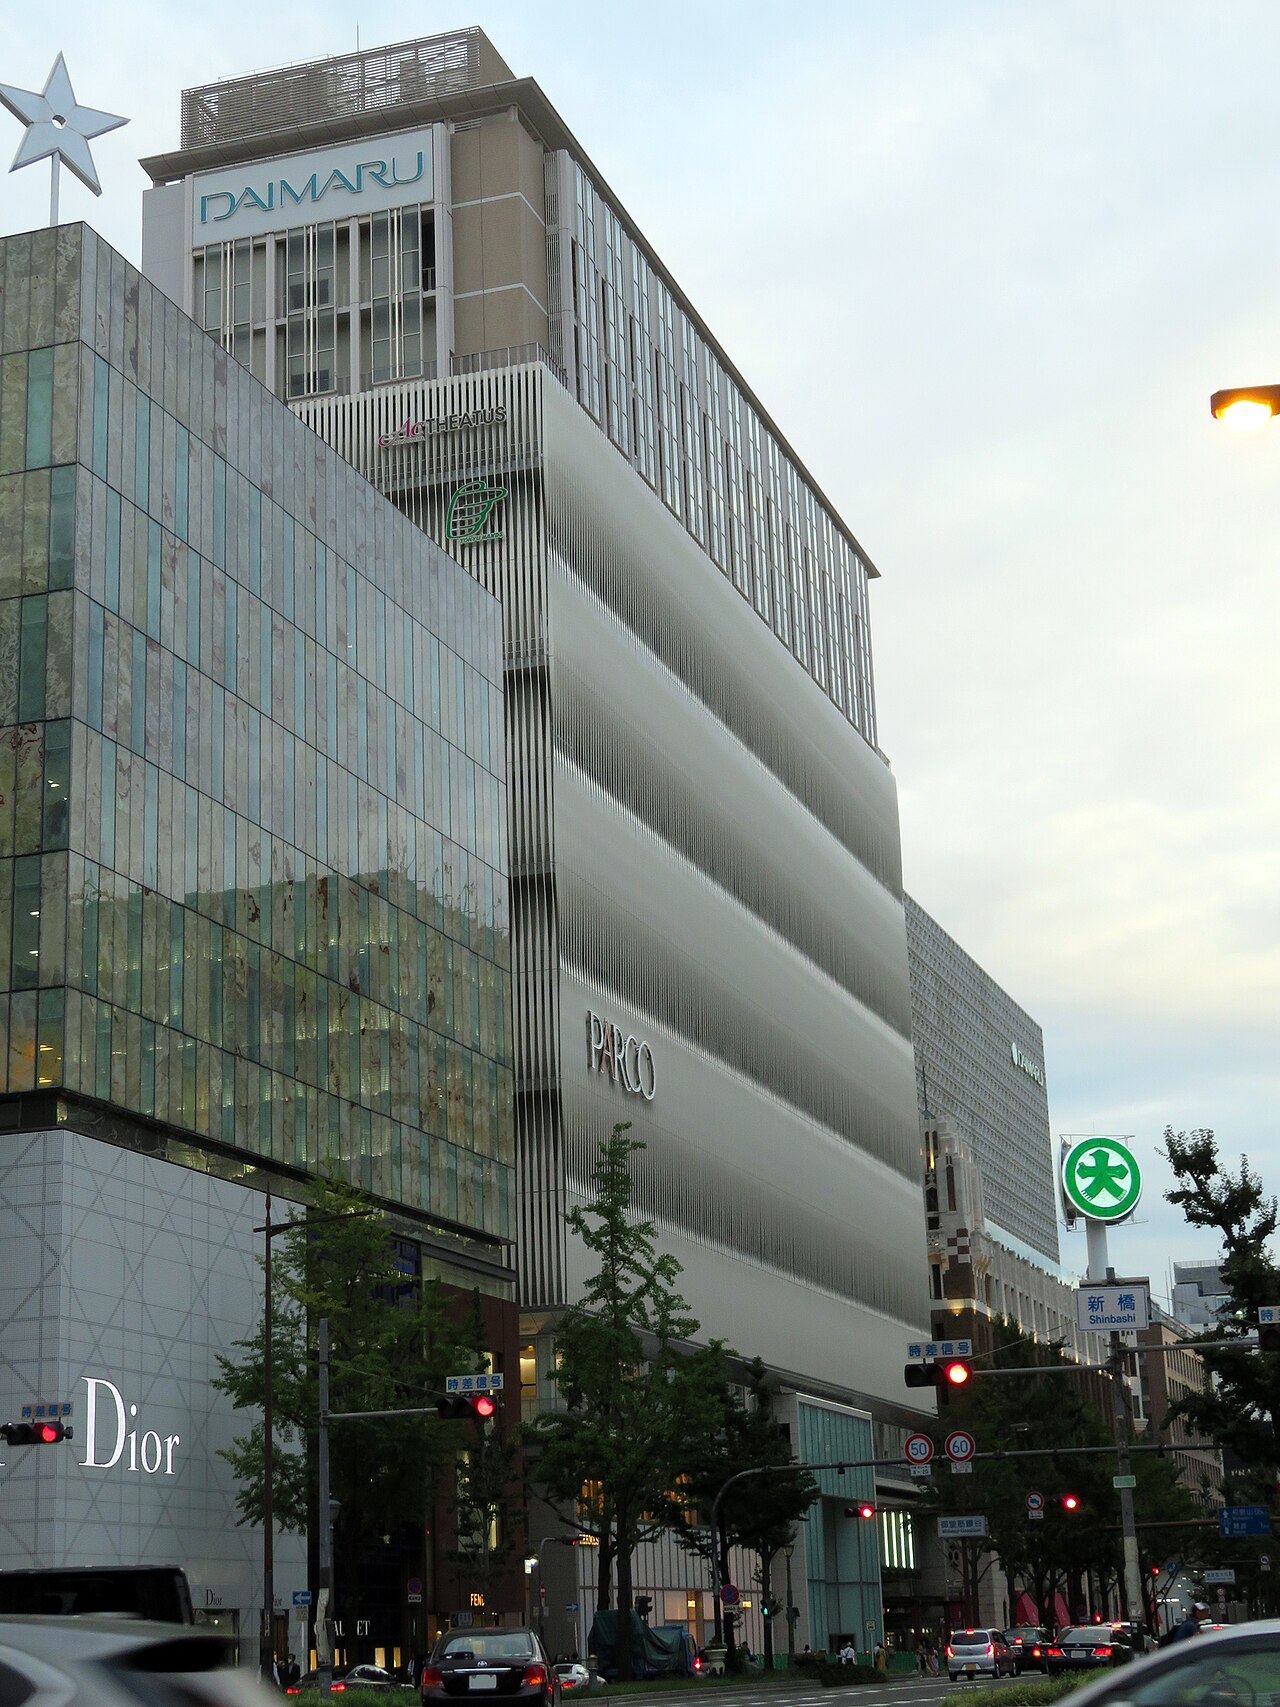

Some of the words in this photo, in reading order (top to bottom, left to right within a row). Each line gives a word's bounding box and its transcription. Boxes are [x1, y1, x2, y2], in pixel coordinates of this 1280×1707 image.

[201, 151, 423, 224] DAIMARU
[586, 1009, 656, 1100] PARCO
[1087, 1293, 1136, 1312] 新橋
[1089, 1313, 1136, 1324] Shinbashi
[909, 1342, 969, 1356] 時差信号
[447, 1375, 501, 1390] 時差信号
[78, 1376, 181, 1474] Dior
[911, 1442, 927, 1456] 50
[952, 1440, 968, 1453] 60
[205, 1589, 223, 1606] Dior
